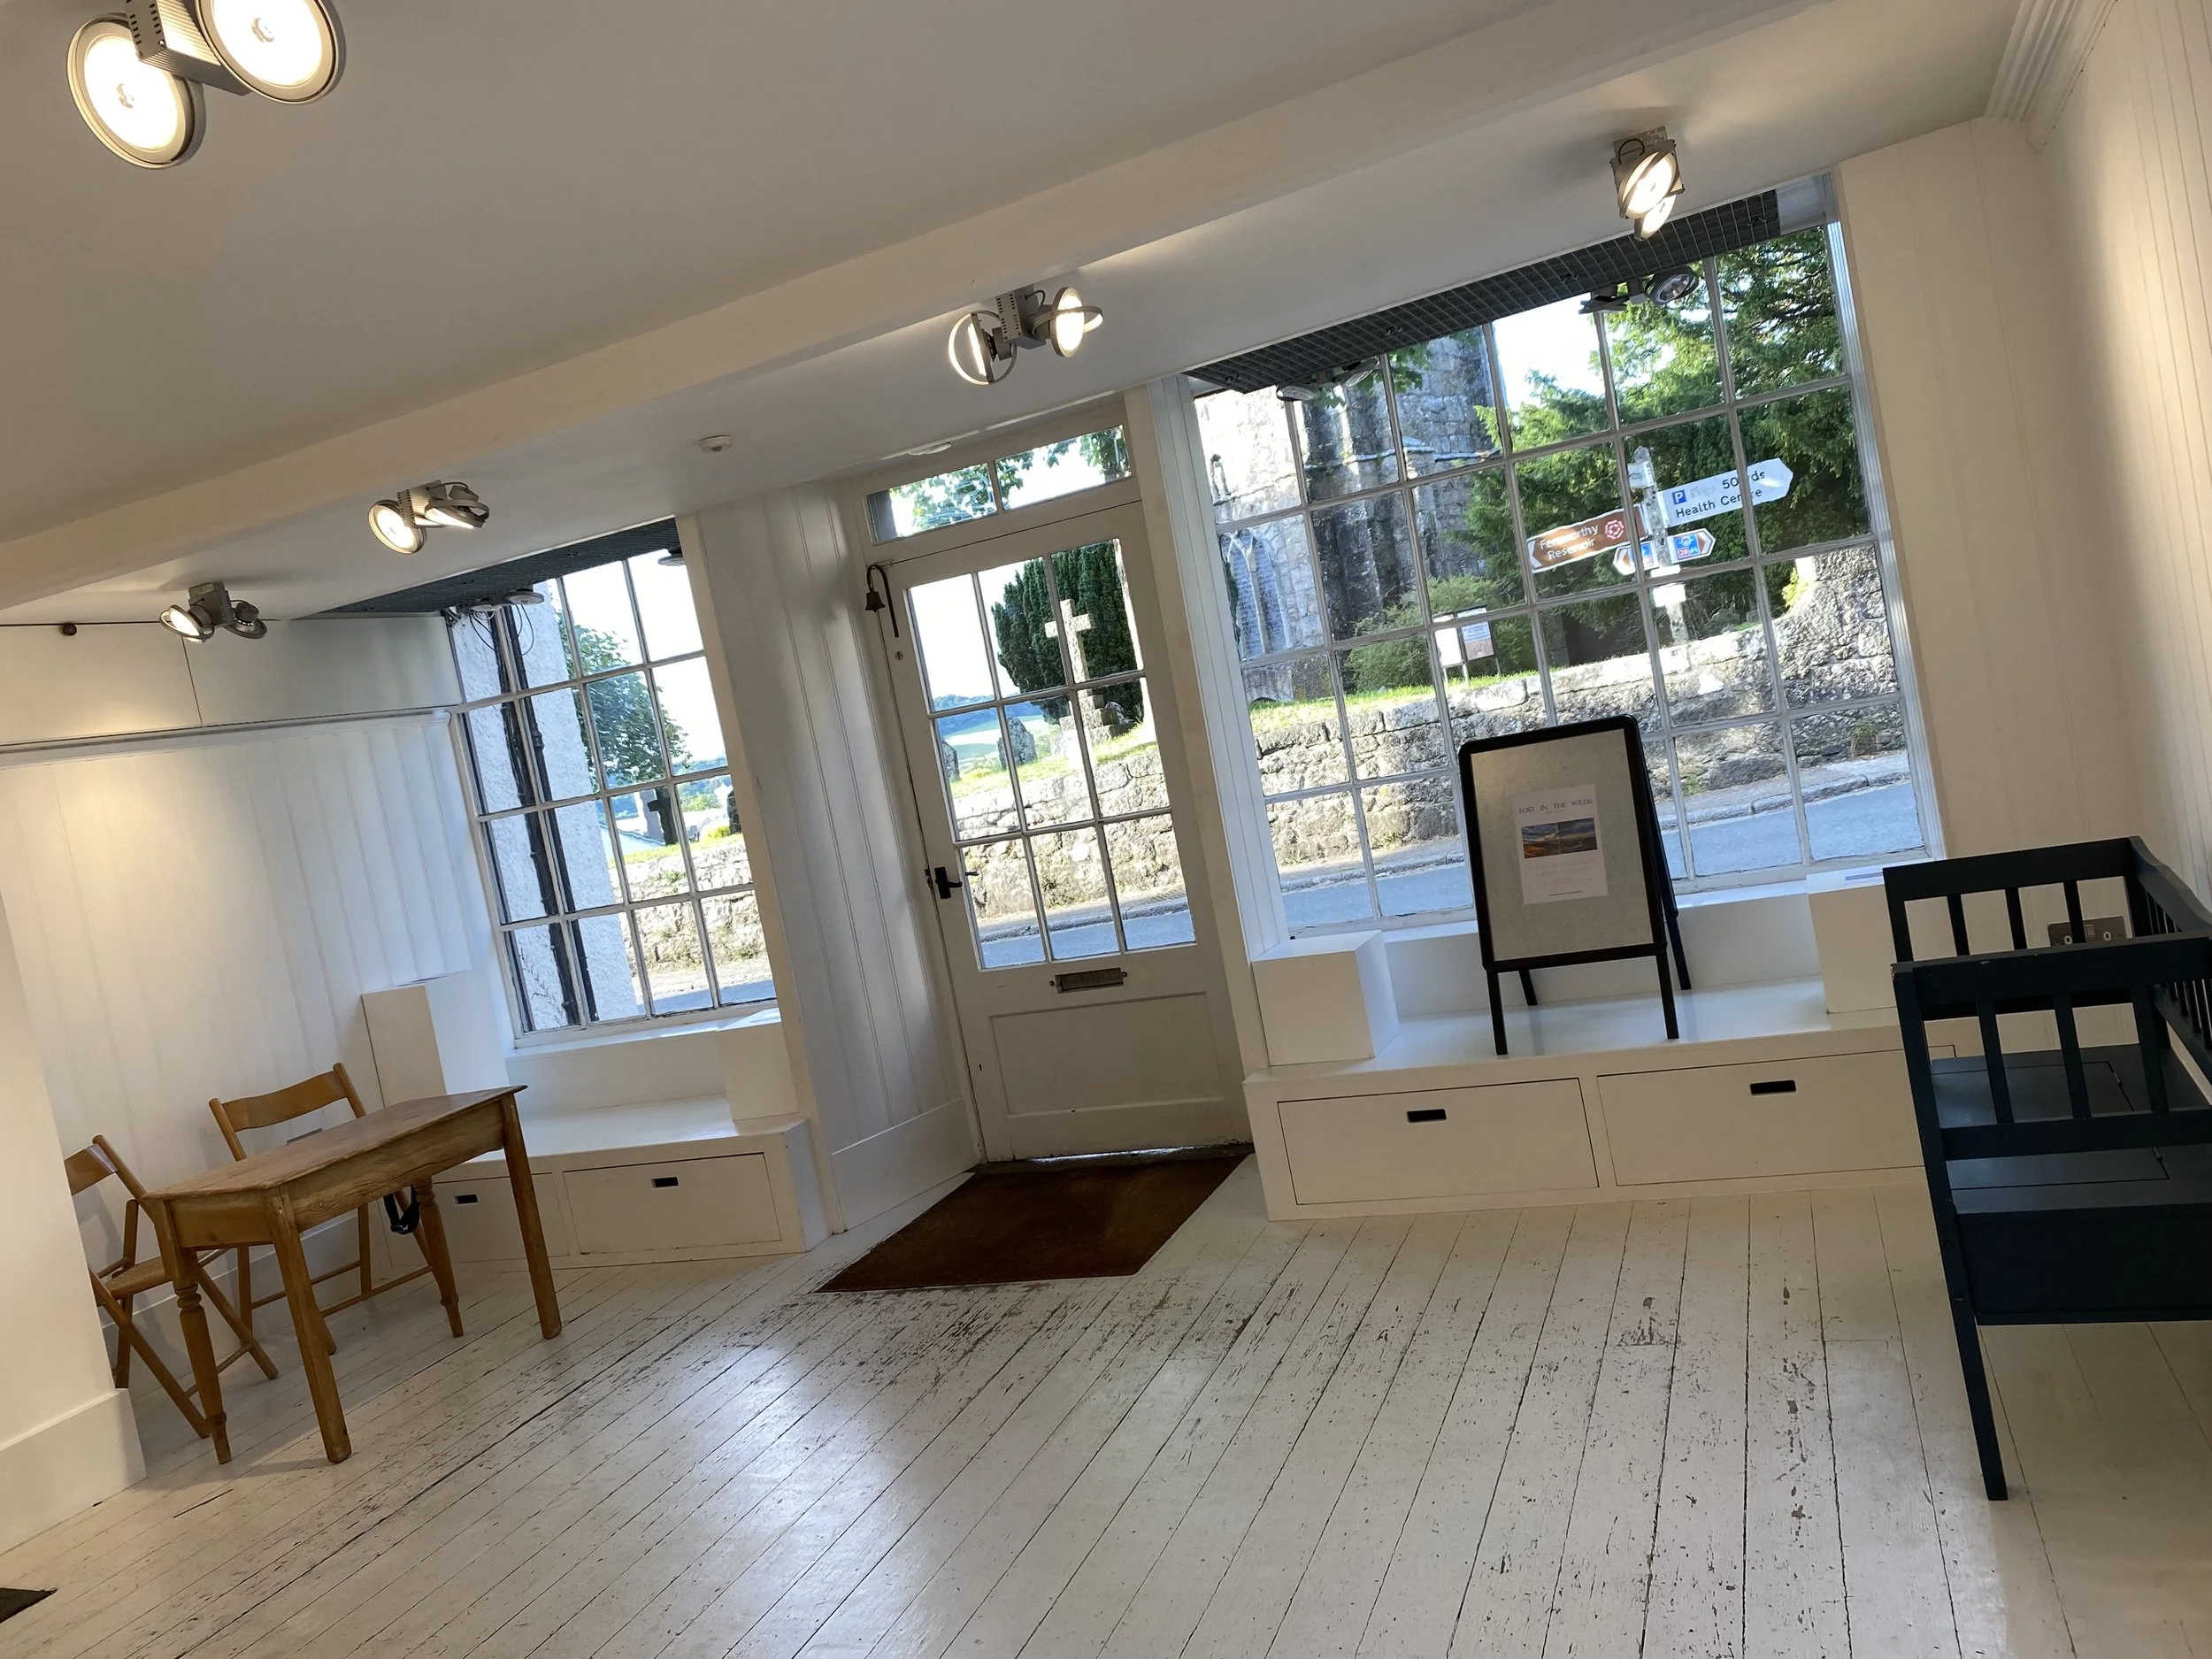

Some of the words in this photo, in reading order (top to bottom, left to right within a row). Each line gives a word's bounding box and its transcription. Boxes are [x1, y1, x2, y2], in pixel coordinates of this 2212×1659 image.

[1722, 476, 1740, 489] 50
[1676, 501, 1717, 518] Health
[1720, 488, 1763, 506] Cenre
[1540, 525, 1599, 550] Ferorthy
[1547, 538, 1595, 561] Reseroir
[1518, 806, 1536, 815] LOST
[1571, 798, 1593, 807] WILDS
